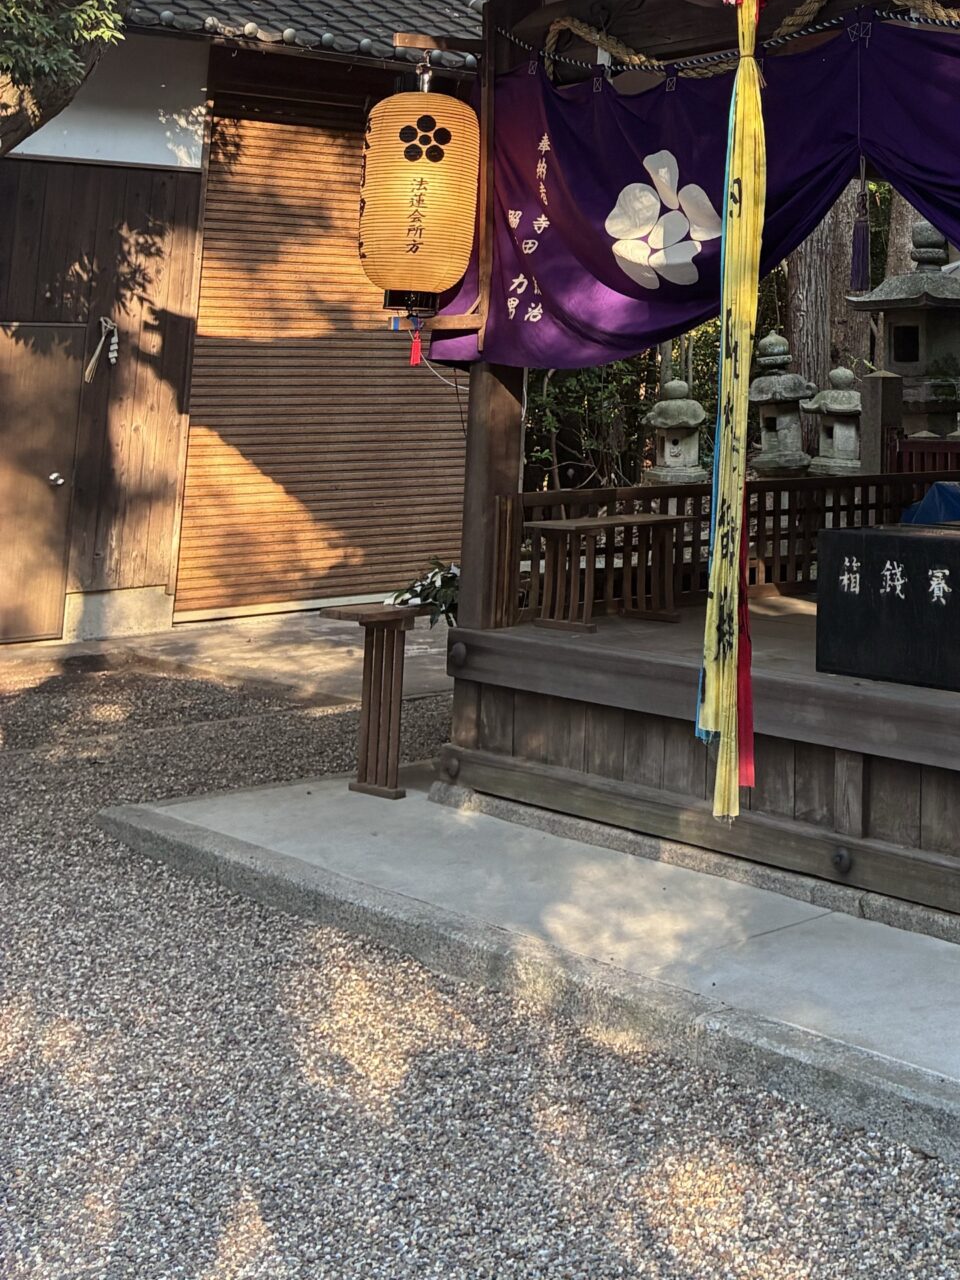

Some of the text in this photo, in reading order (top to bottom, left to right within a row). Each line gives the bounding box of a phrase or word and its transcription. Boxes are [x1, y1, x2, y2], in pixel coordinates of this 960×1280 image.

[405, 177, 429, 254] 法蓮会所方
